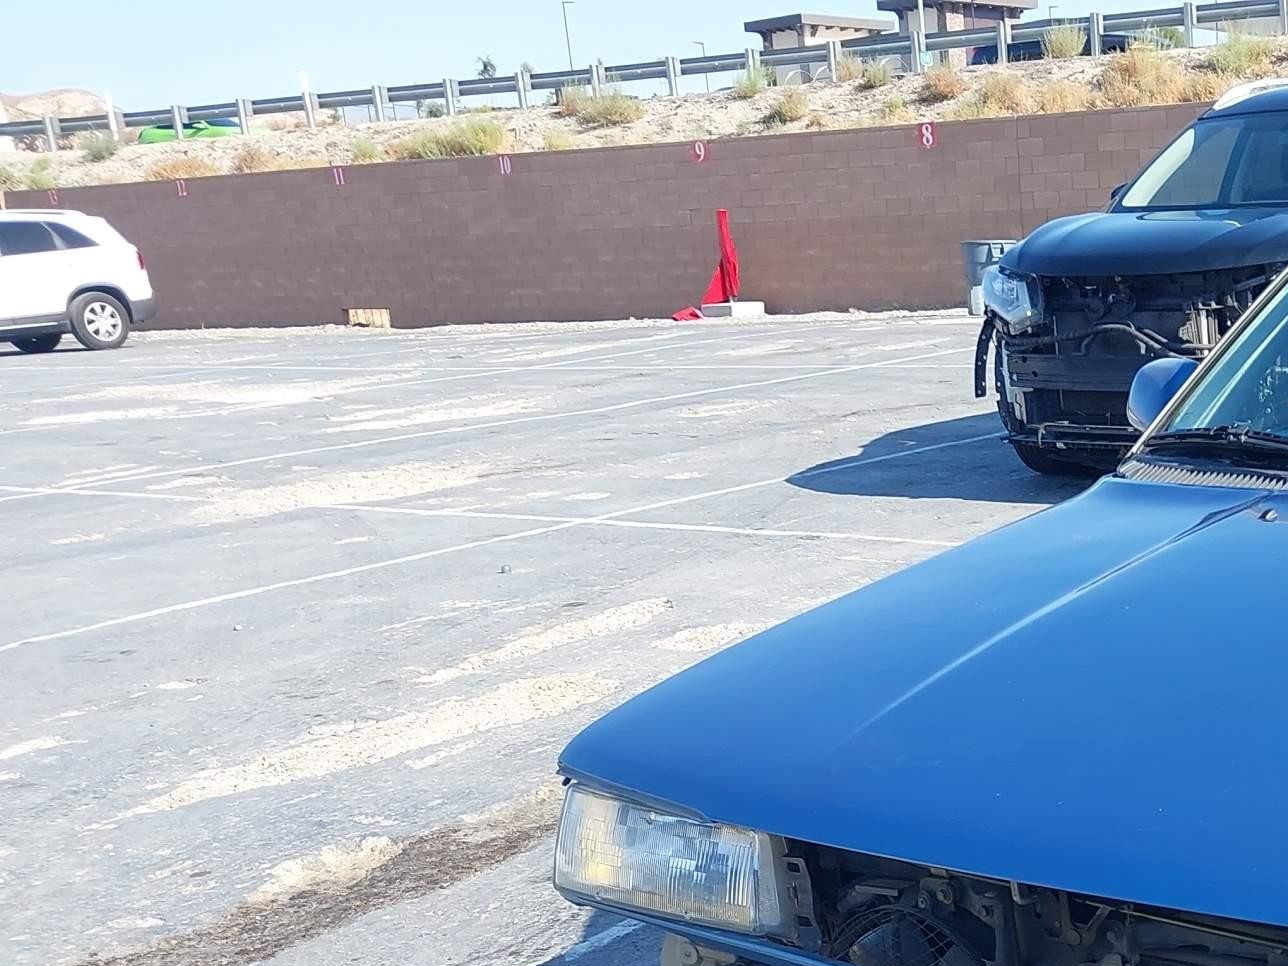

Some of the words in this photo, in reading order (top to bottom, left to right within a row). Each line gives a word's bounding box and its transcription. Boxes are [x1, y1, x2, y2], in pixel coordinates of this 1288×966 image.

[921, 123, 933, 146] 8
[695, 141, 705, 162] 9
[499, 155, 511, 175] 10
[333, 167, 345, 185] 11
